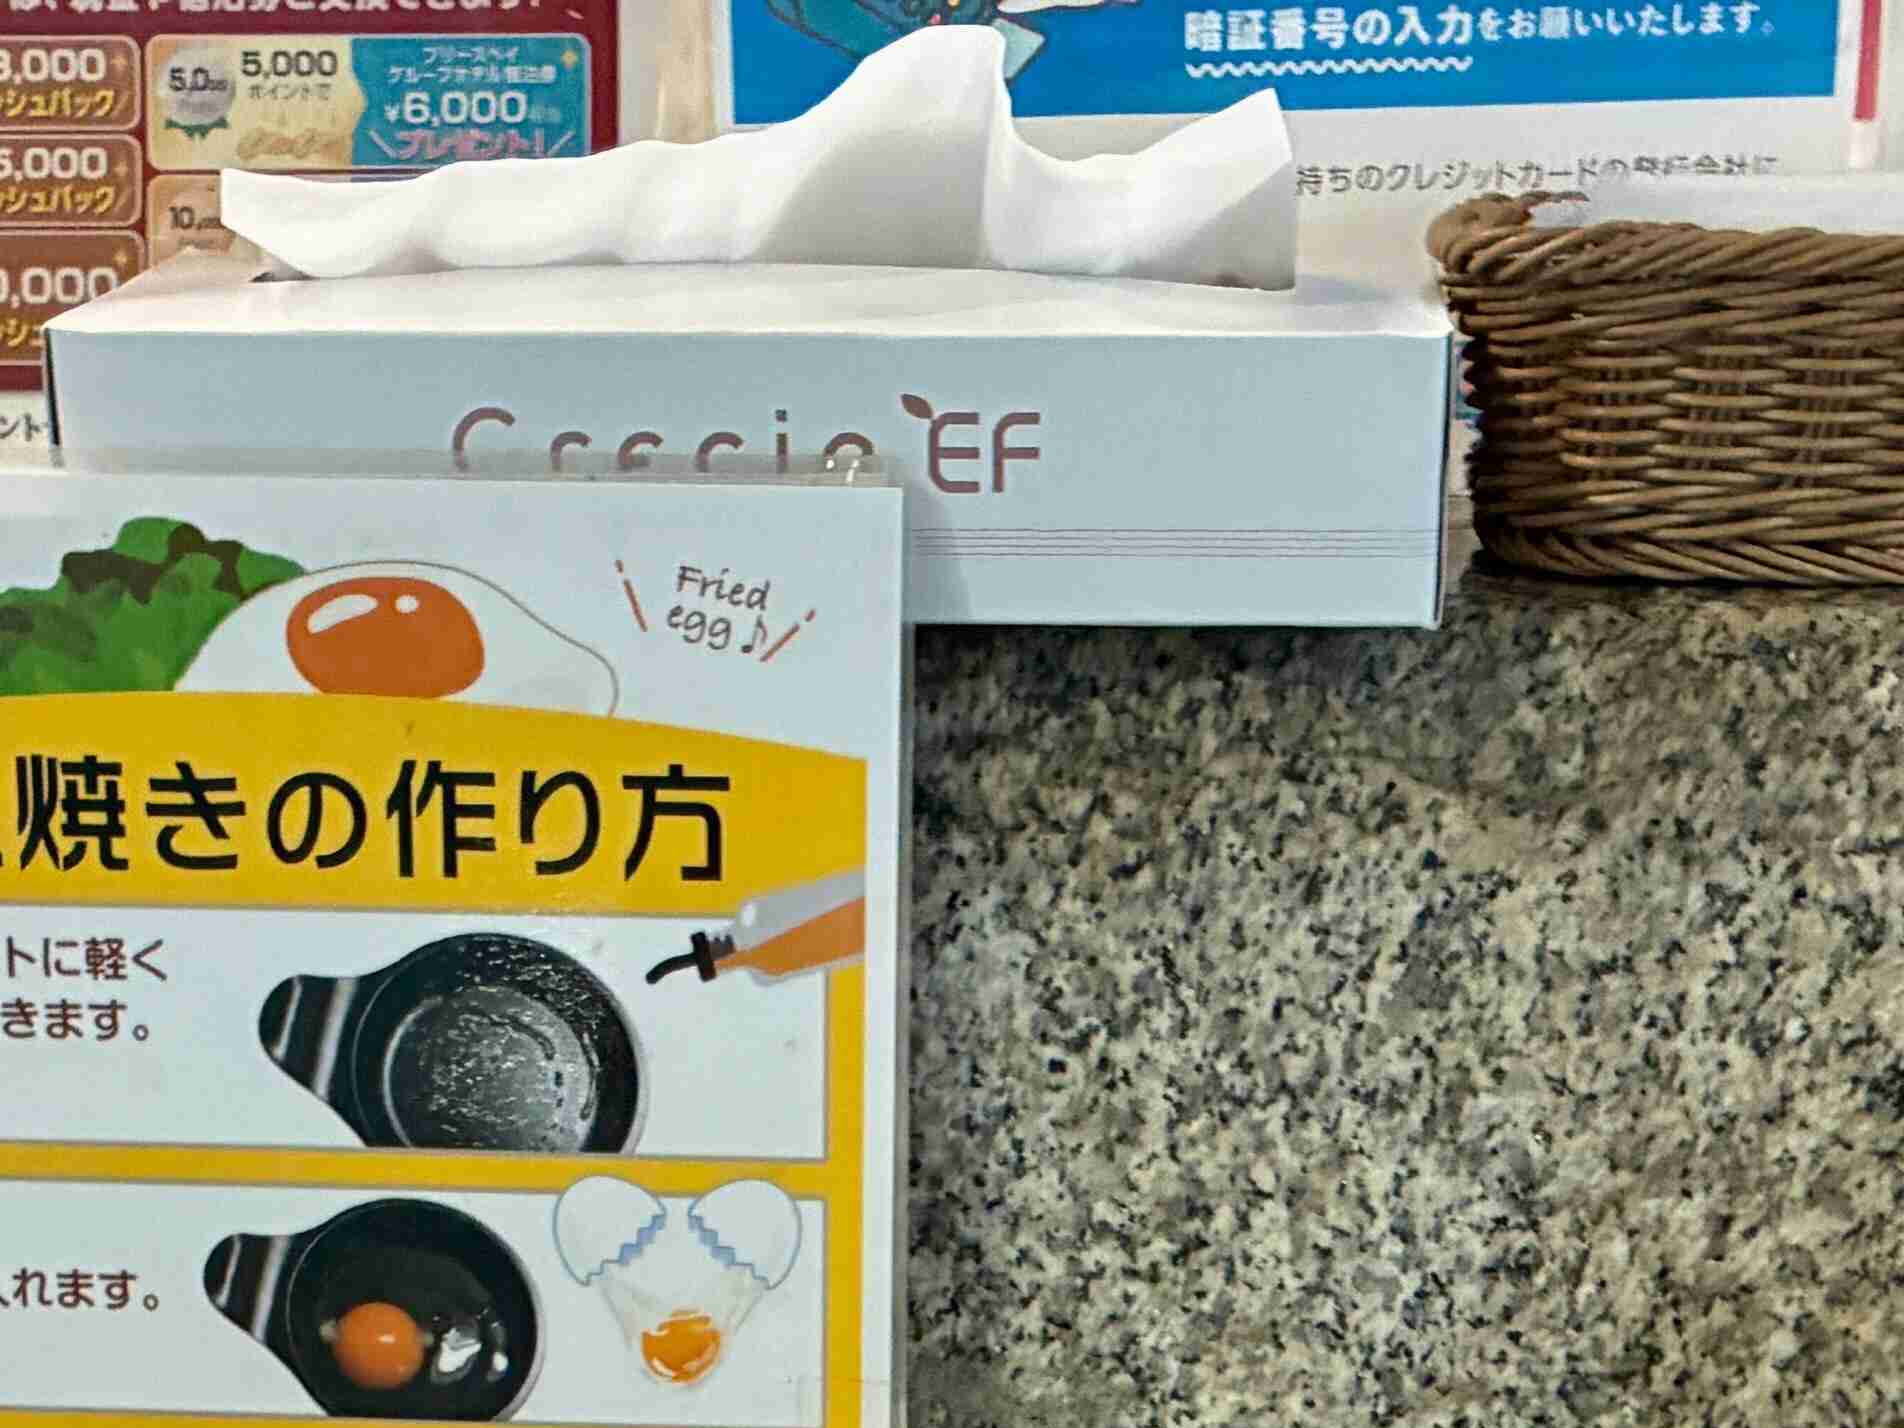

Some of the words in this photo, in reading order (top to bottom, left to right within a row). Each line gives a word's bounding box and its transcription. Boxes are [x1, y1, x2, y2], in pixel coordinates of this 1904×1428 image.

[1184, 2, 1776, 51] 暗証番号の入力をお願いいたします。
[241, 50, 339, 79] 5,000
[928, 411, 1041, 493] EF
[675, 564, 770, 613] Fried
[665, 602, 733, 651] egg
